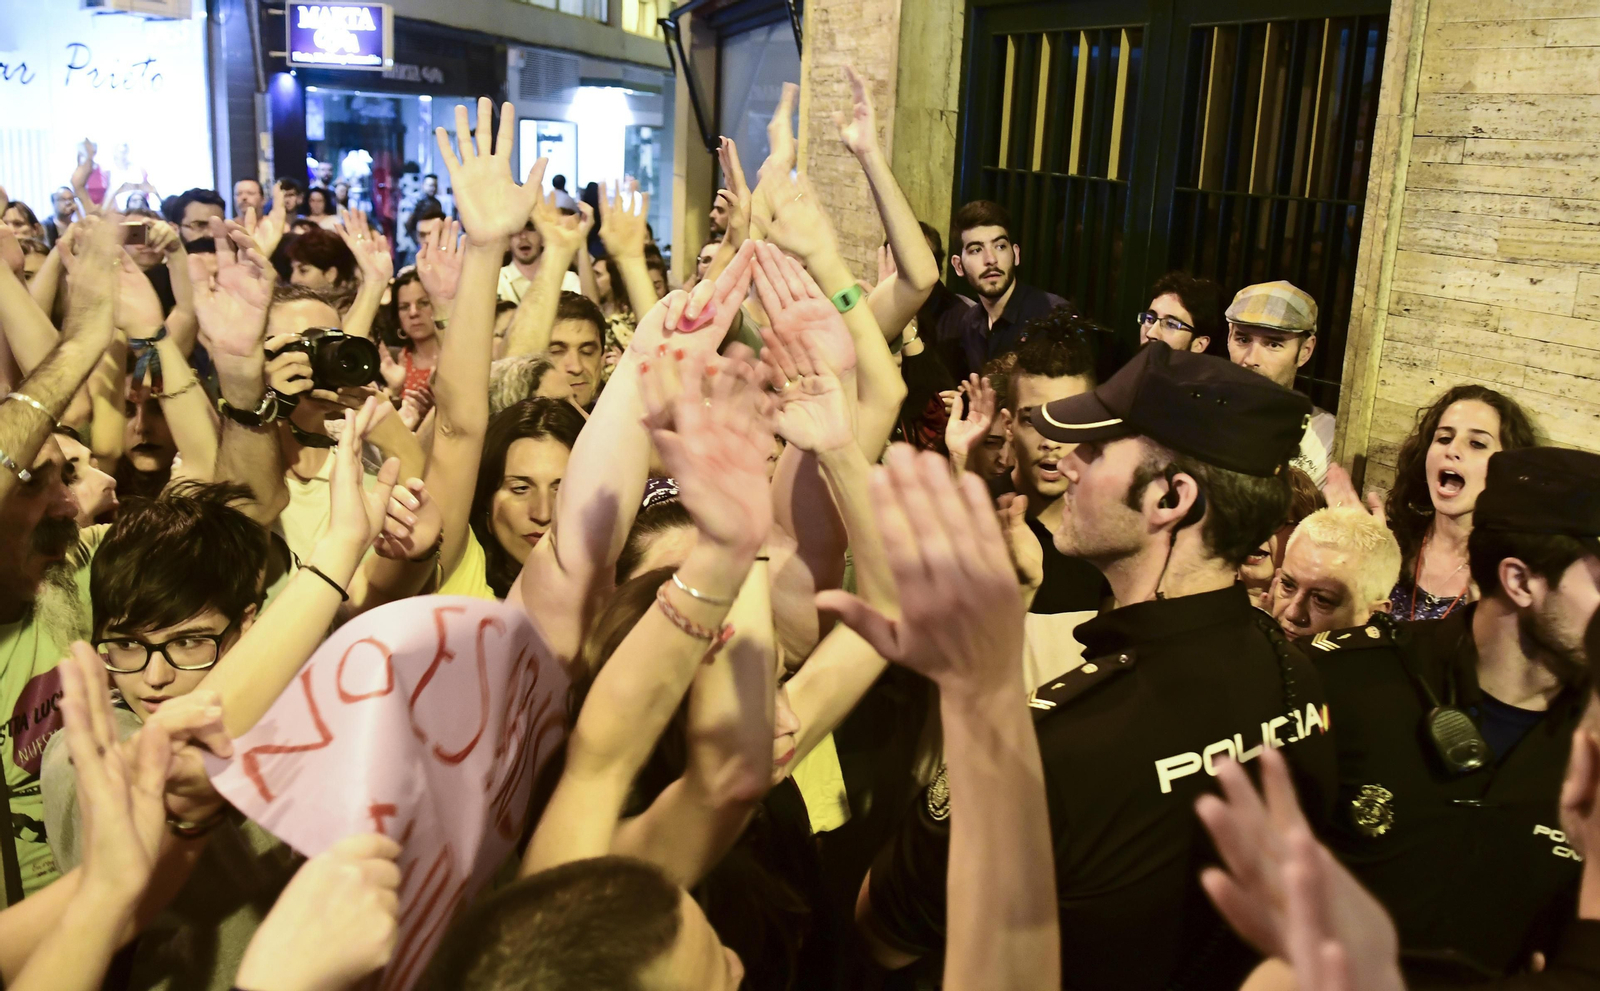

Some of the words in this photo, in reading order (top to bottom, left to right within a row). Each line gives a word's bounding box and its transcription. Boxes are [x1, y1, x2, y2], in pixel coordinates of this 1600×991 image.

[297, 5, 376, 31] MARTA
[65, 42, 164, 91] Prieto
[34, 690, 63, 725] LUC
[1154, 702, 1324, 794] POLICIA
